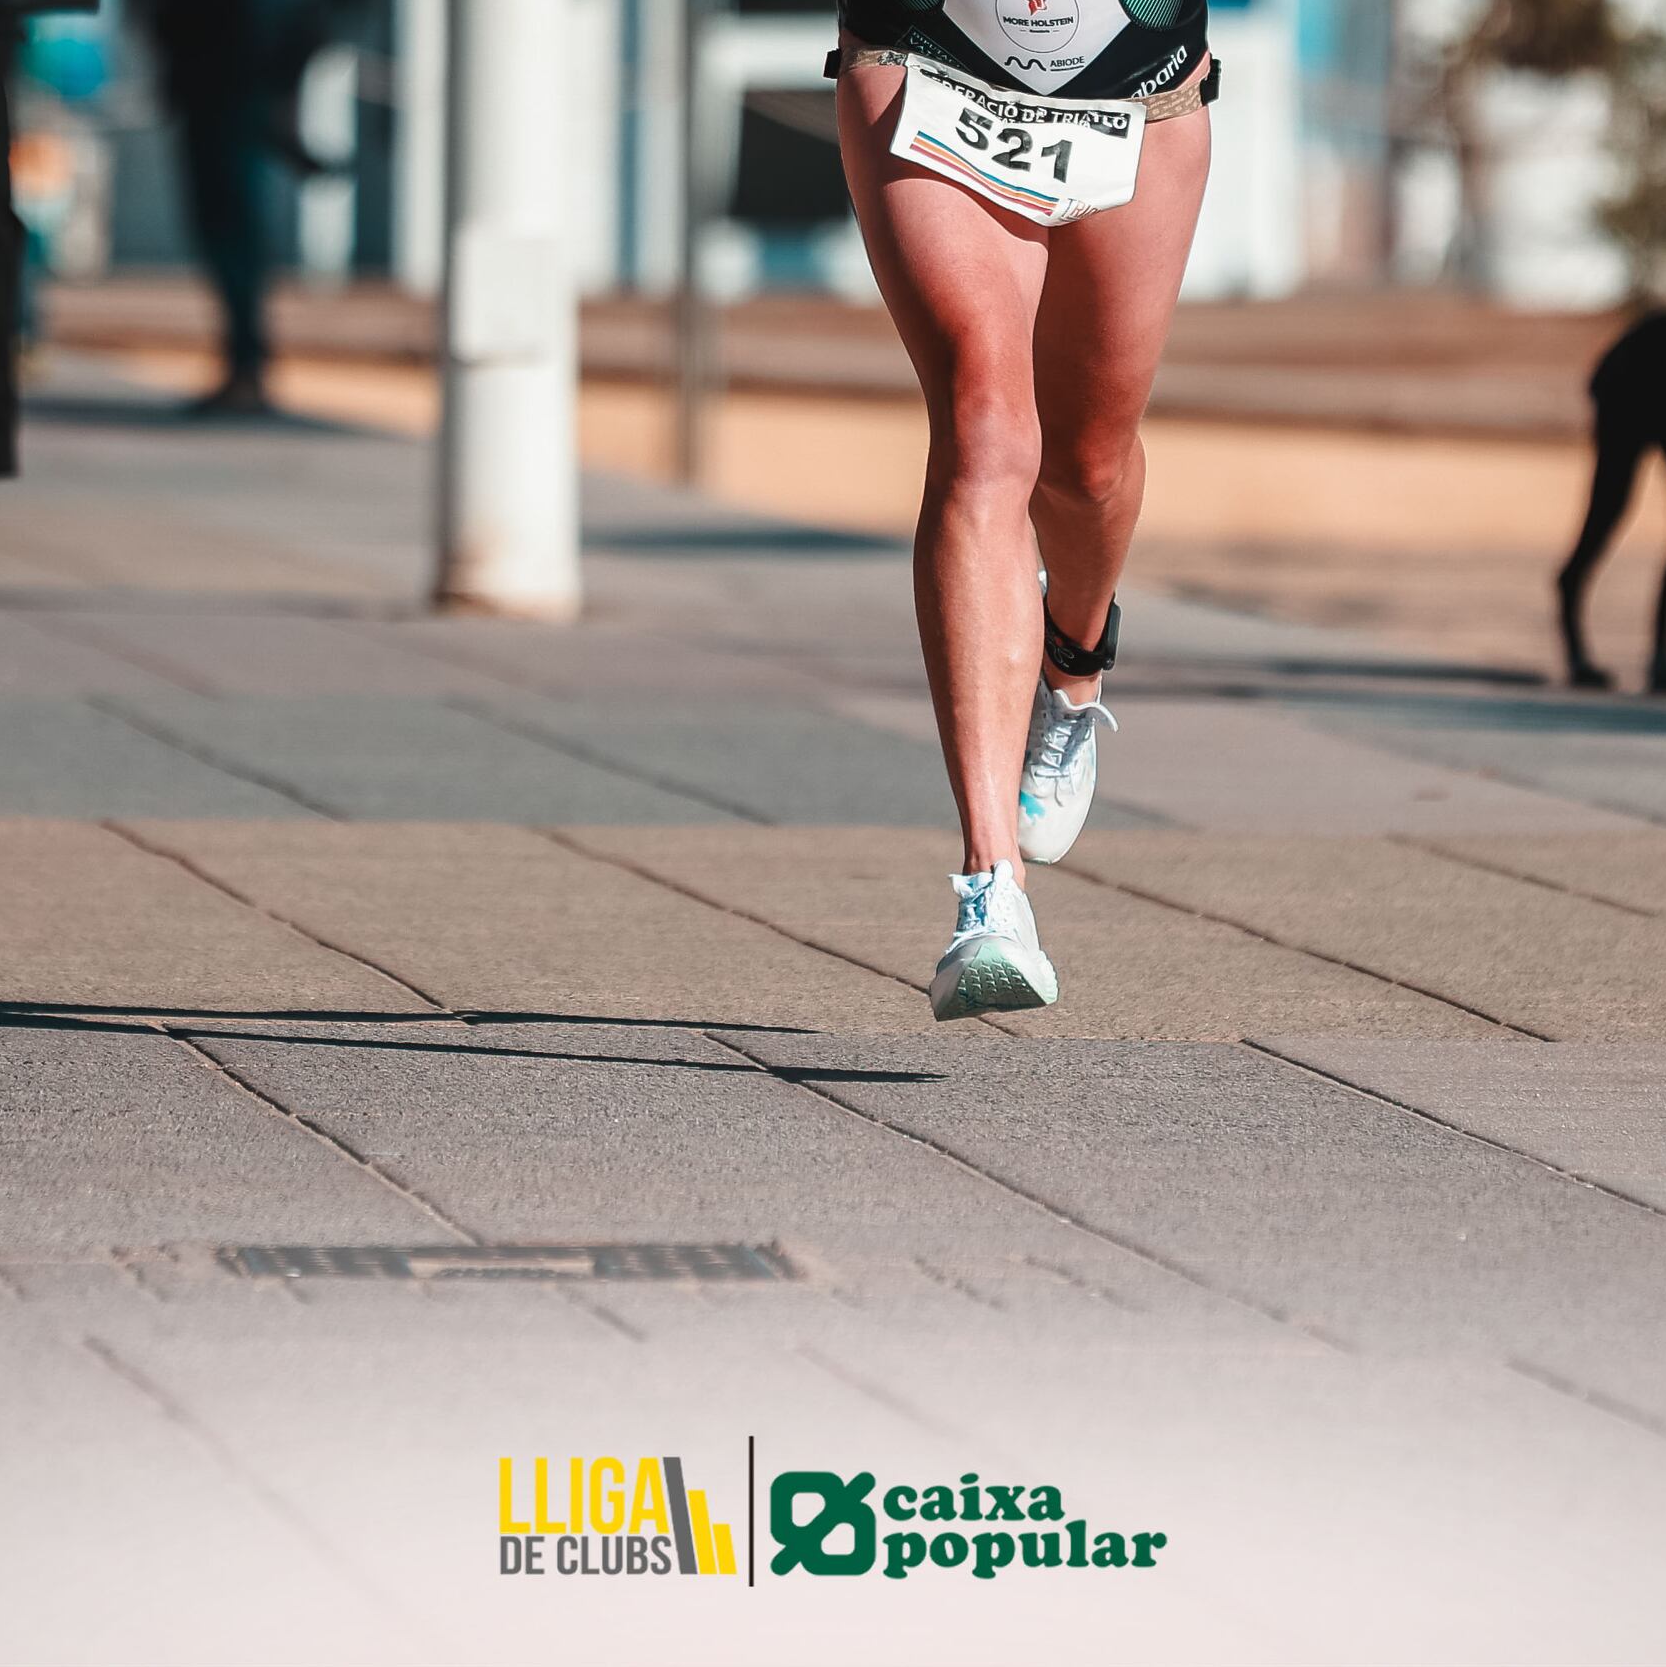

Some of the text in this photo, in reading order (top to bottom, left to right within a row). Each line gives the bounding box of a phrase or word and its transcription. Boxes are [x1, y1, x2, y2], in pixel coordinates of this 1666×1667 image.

[1002, 16, 1074, 27] MORE HOLSTEIN
[1050, 56, 1085, 68] ABIODE
[955, 107, 1073, 184] 521
